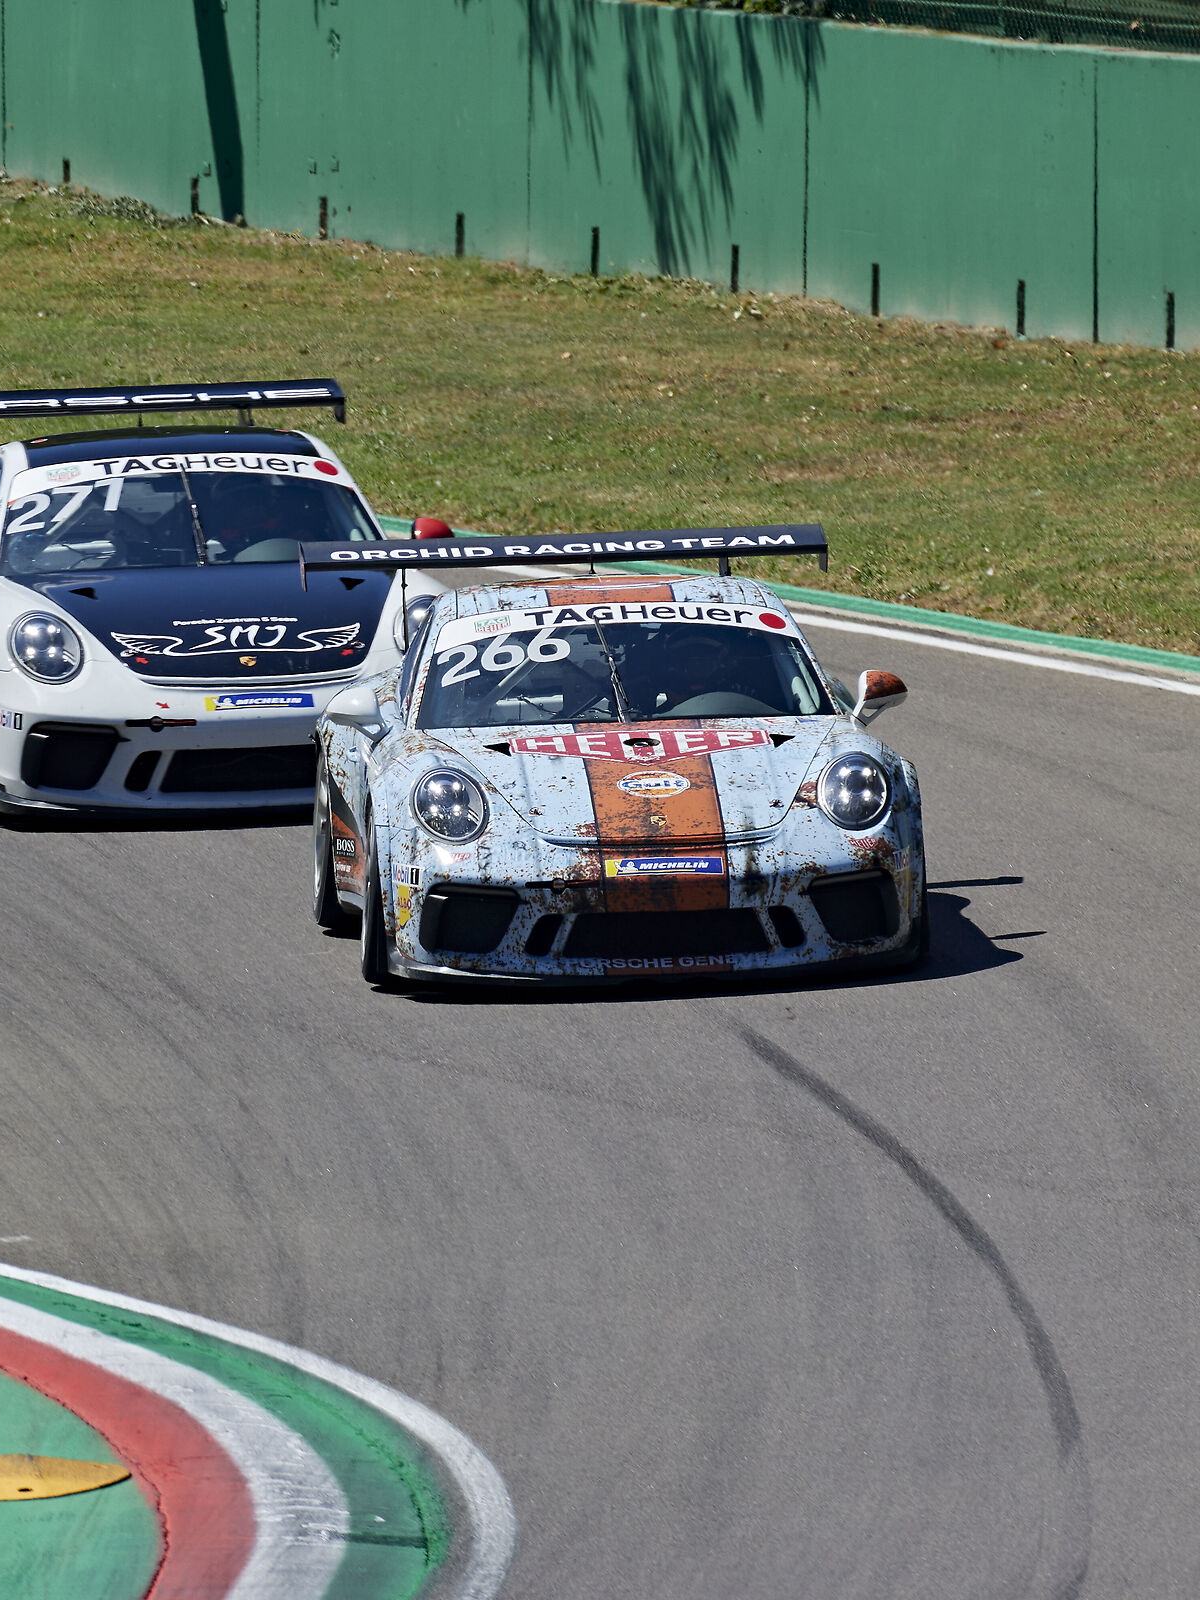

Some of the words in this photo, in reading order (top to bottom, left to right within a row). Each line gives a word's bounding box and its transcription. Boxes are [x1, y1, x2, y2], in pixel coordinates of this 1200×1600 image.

[330, 546, 494, 561] ORCHID
[504, 540, 666, 556] RACING
[672, 534, 796, 549] TEAM
[188, 624, 288, 650] SMJ
[437, 627, 571, 688] 266
[235, 697, 303, 706] MICHELIN
[525, 730, 755, 760] HEUER
[336, 838, 355, 853] BOSS
[392, 863, 410, 884] Mobil
[639, 861, 710, 870] MICHELIN
